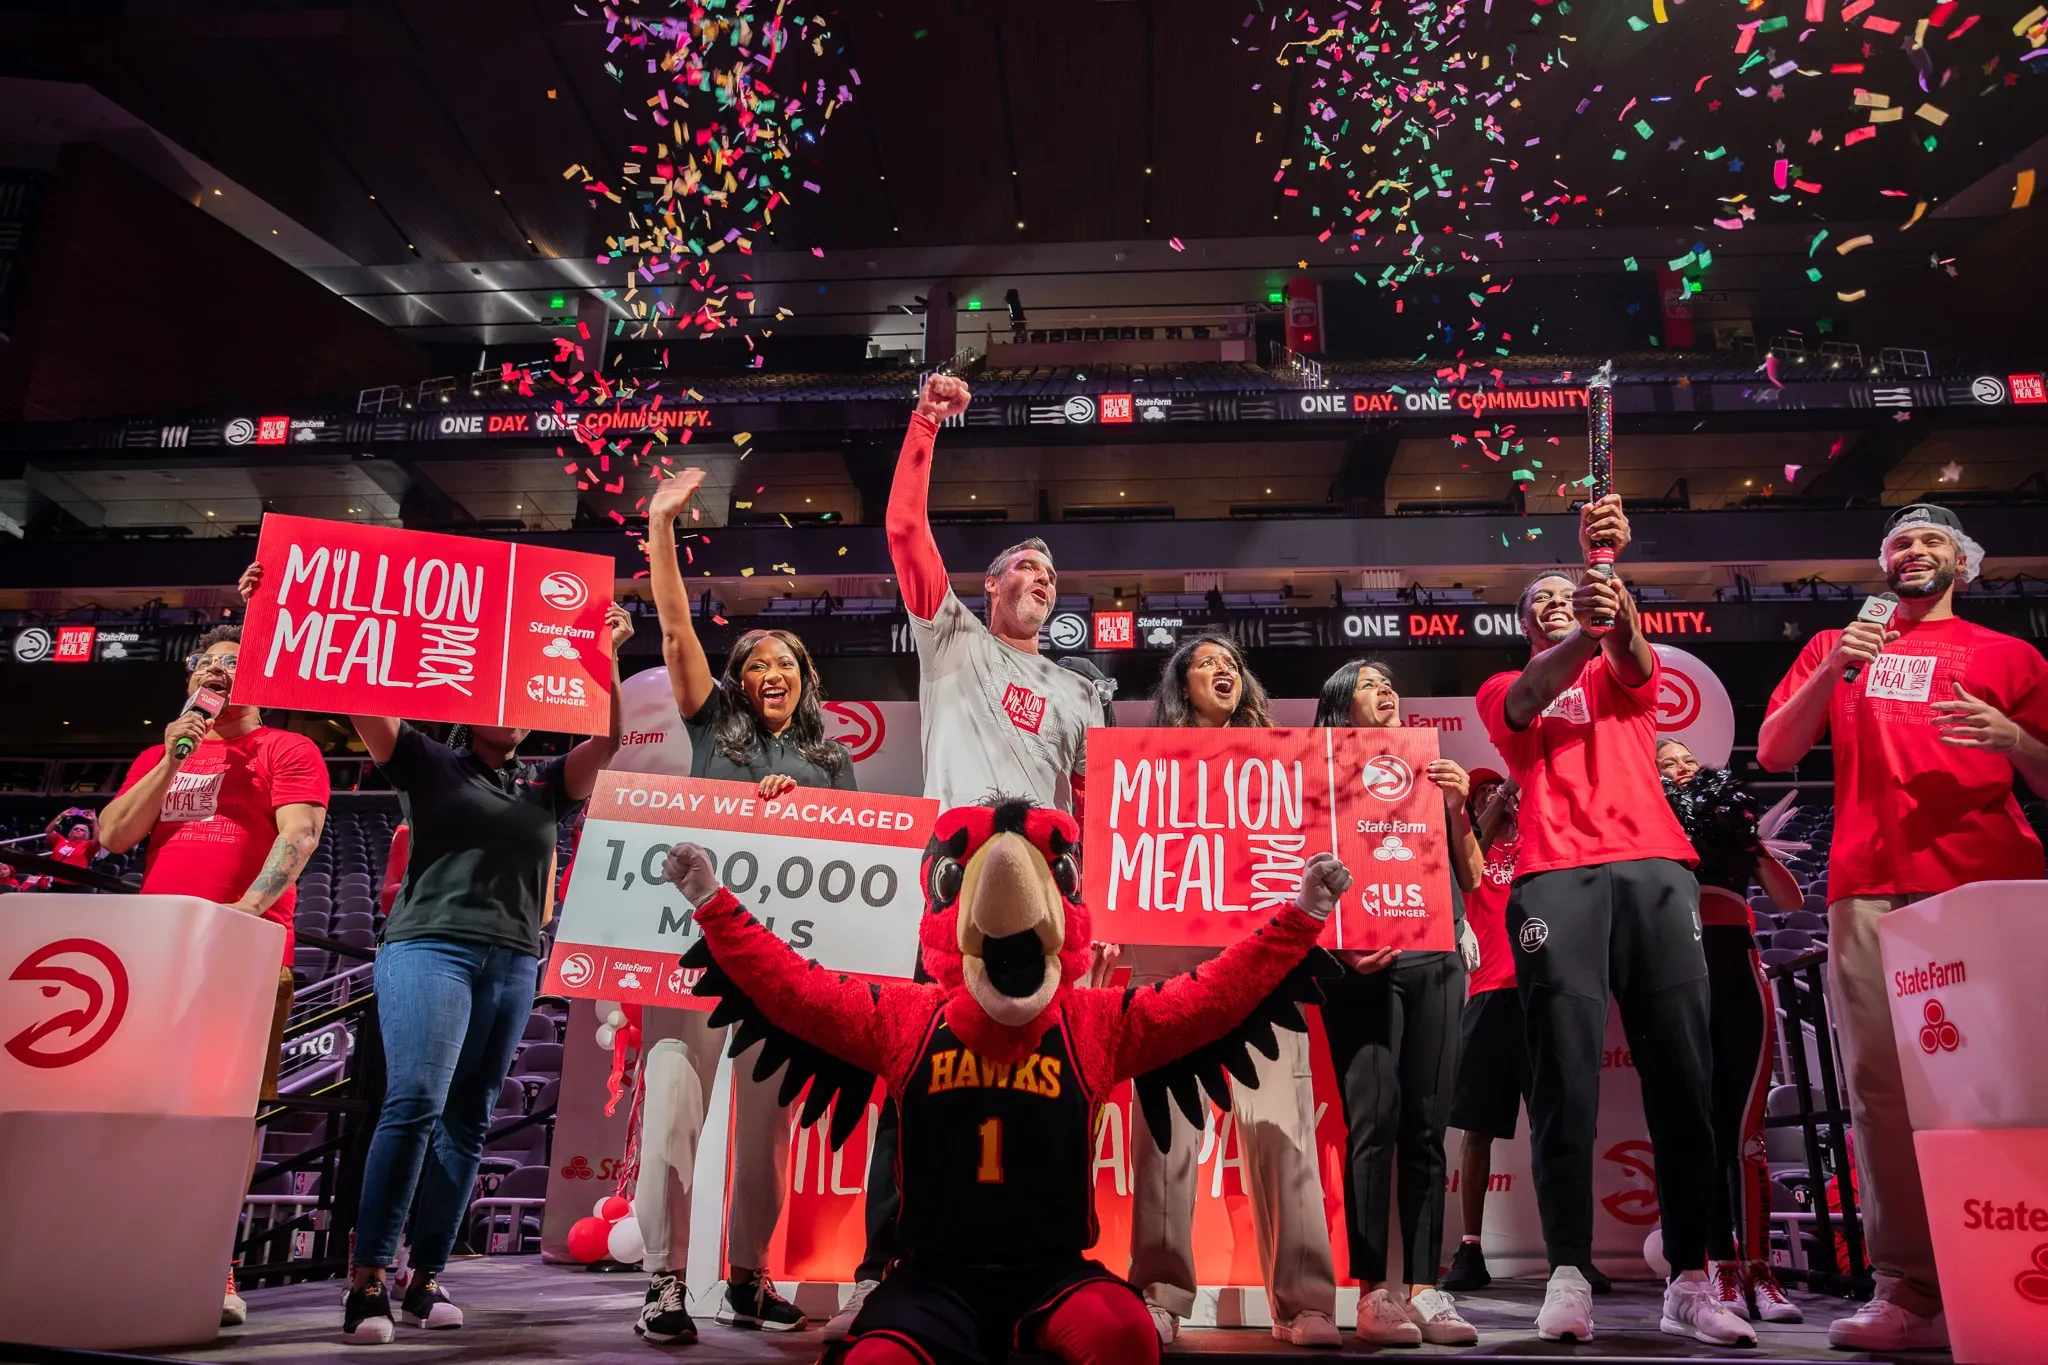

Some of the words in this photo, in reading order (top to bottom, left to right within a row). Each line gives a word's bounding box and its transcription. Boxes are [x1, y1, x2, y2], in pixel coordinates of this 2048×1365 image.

[1300, 395, 1346, 413] ONE
[1353, 394, 1399, 412] DAY.
[1405, 393, 1451, 411] ONE
[440, 417, 483, 434] ONE
[488, 416, 530, 433] DAY.
[536, 414, 580, 431] ONE
[585, 410, 713, 429] COMMUNITY.
[277, 543, 484, 623] MILLION
[529, 621, 595, 639] StateFarm
[1098, 616, 1130, 629] MILLION
[1343, 615, 1400, 637] ONE
[1410, 614, 1465, 636] DAY.
[1637, 611, 1712, 633] NITY.
[1098, 628, 1120, 642] MEAL
[264, 608, 414, 688] MEAL
[416, 622, 480, 697] PACK
[1875, 656, 1932, 674] MILLION
[546, 675, 586, 698] U.S.
[1871, 669, 1909, 691] MEAL
[546, 696, 586, 707] HUNGER
[621, 731, 665, 746] eFarm
[168, 775, 220, 793] MILLION
[1109, 758, 1304, 830] MILLION
[165, 791, 198, 811] MEAL
[615, 787, 706, 812] TODAY
[713, 796, 757, 817] WE
[764, 801, 915, 831] PACKAGED
[1356, 820, 1427, 833] StateFarm
[606, 839, 898, 907] 1,00,000
[1107, 832, 1249, 912] MEAL
[1247, 834, 1306, 912] PACK
[1381, 883, 1425, 907] U.S.
[1383, 908, 1427, 918] HUNGER
[1523, 926, 1543, 943] ATL
[1895, 960, 1966, 998] StateFarm
[928, 1047, 1062, 1099] HAWKS
[976, 1116, 1004, 1184] 1
[1963, 1198, 2048, 1233] State
